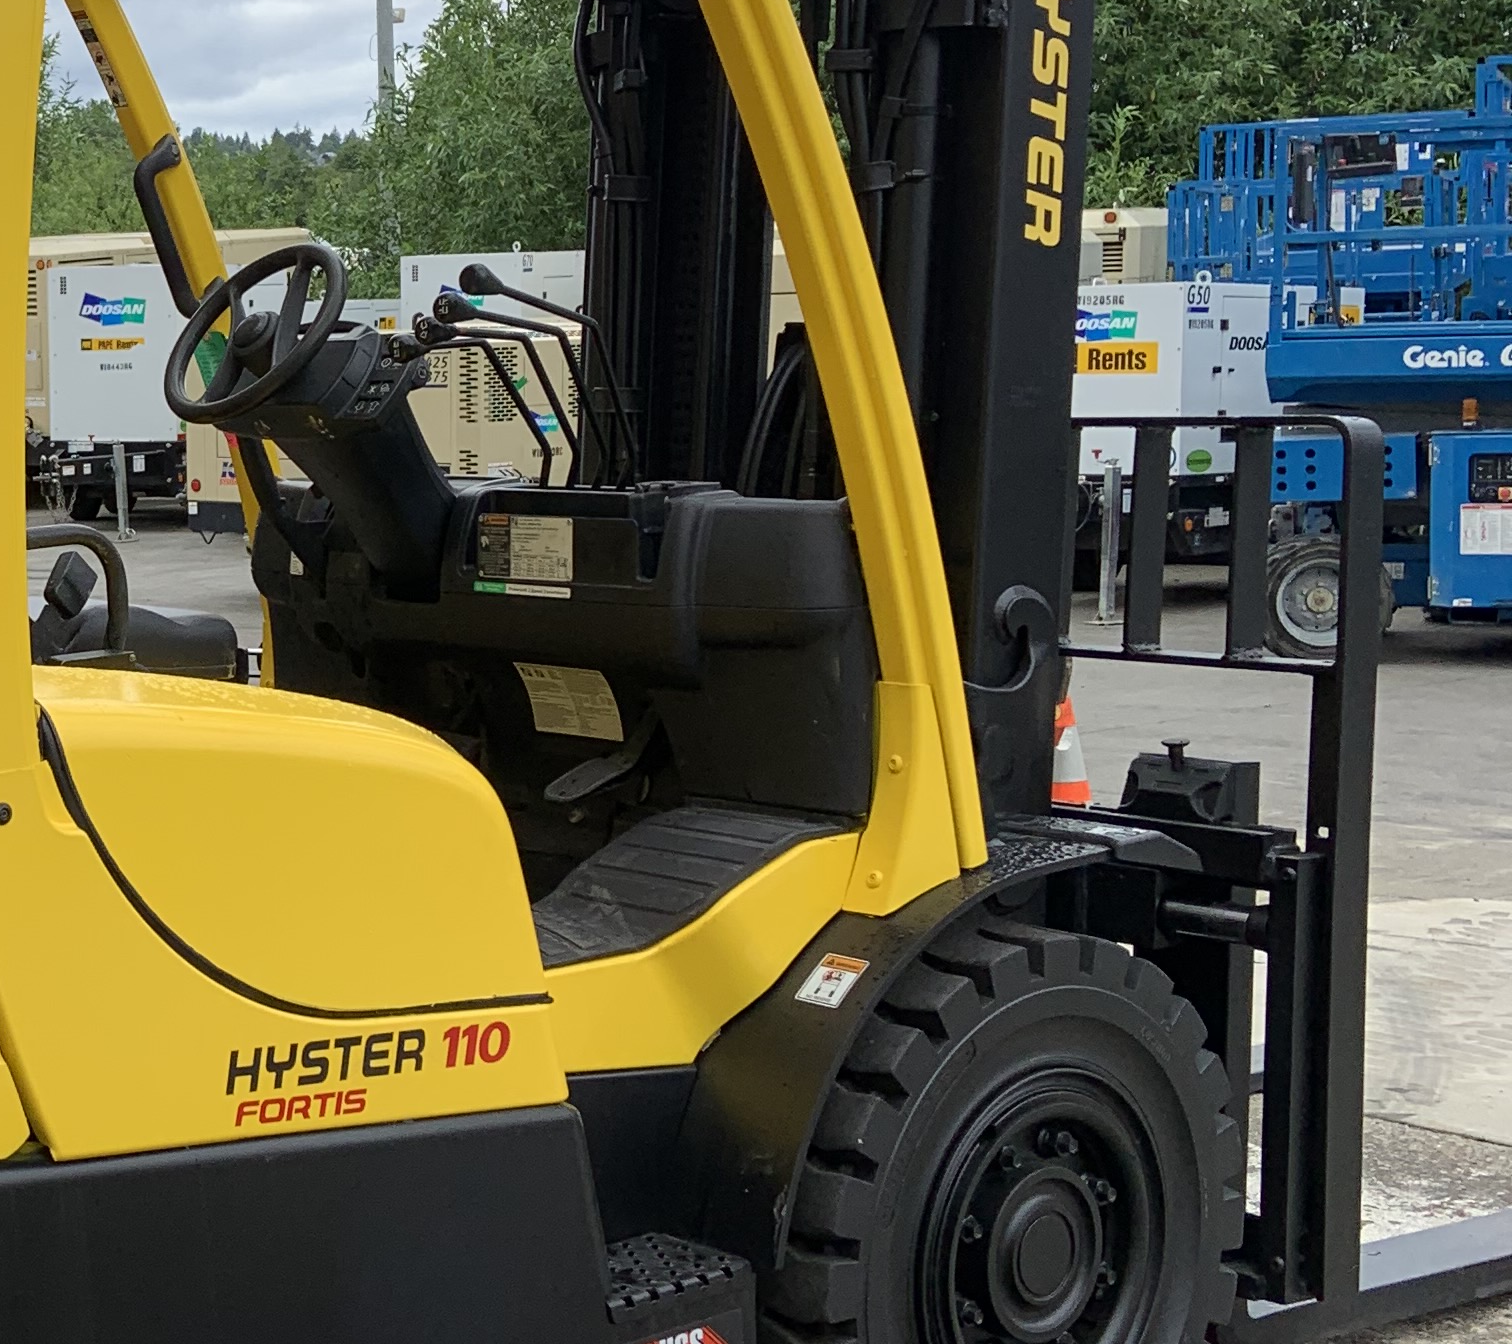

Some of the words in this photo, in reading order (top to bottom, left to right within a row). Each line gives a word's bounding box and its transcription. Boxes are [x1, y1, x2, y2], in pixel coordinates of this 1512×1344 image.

[1187, 284, 1211, 305] G50
[81, 303, 144, 316] DOOSAN
[1074, 317, 1136, 331] OOSAN
[1229, 336, 1267, 351] DOOS
[1087, 348, 1147, 371] Rents
[1402, 344, 1486, 369] Genie
[225, 1028, 426, 1095] HYSTER
[442, 1021, 511, 1069] 110
[234, 1088, 368, 1128] FORTIS
